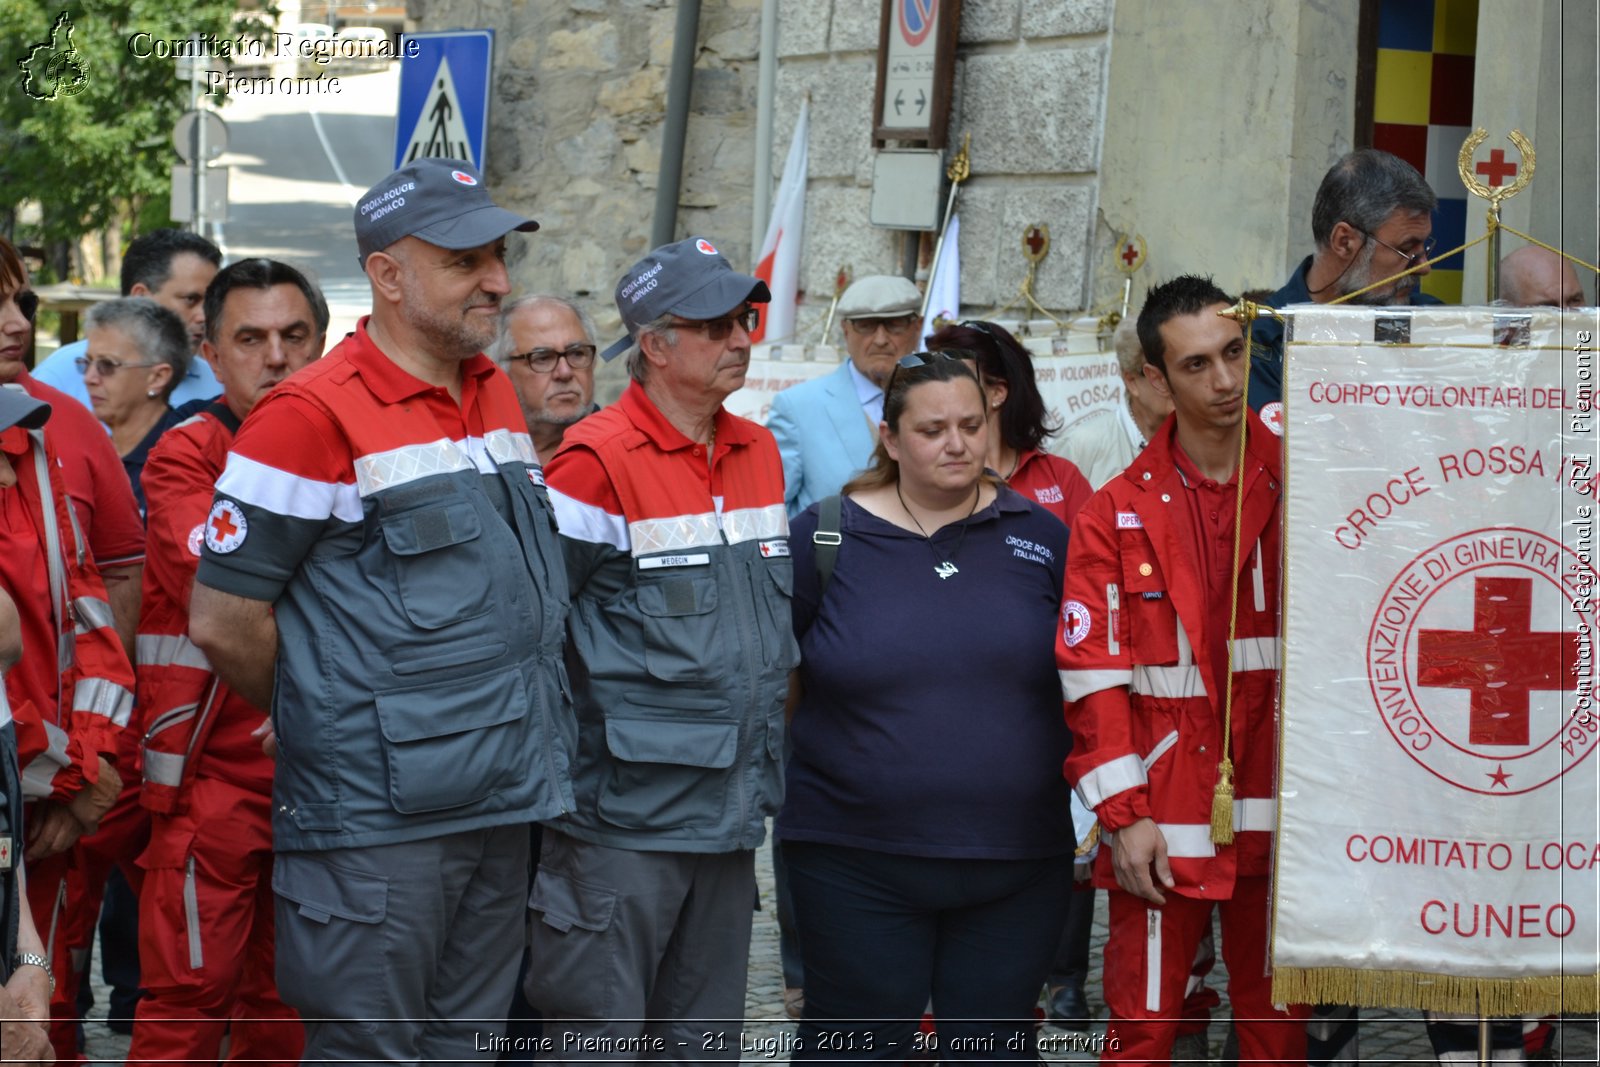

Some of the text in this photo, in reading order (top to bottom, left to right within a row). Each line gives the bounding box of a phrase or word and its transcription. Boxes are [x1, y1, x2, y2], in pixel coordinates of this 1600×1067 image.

[360, 182, 416, 216] CROIX-ROUGE
[370, 197, 406, 223] MONACO
[621, 262, 663, 299] CROIX-ROUGE
[630, 279, 658, 304] MONACO
[1034, 367, 1056, 382] ORPO
[1060, 363, 1109, 381] VOLONTARI
[1066, 384, 1121, 413] ROSSA
[1309, 381, 1391, 406] CORPO
[1396, 385, 1527, 409] VOLONTARI
[1532, 387, 1573, 410] DEL
[1334, 466, 1431, 551] CROCE
[1438, 445, 1545, 483] ROSSA
[1005, 535, 1033, 551] CROCE
[660, 557, 689, 566] MEDECIN
[1374, 573, 1433, 752] CONVENZIONE
[1423, 552, 1452, 582] DI
[1454, 537, 1560, 574] GINEVRA
[1346, 834, 1513, 871] COMITATO
[1420, 899, 1576, 938] CUNEO
